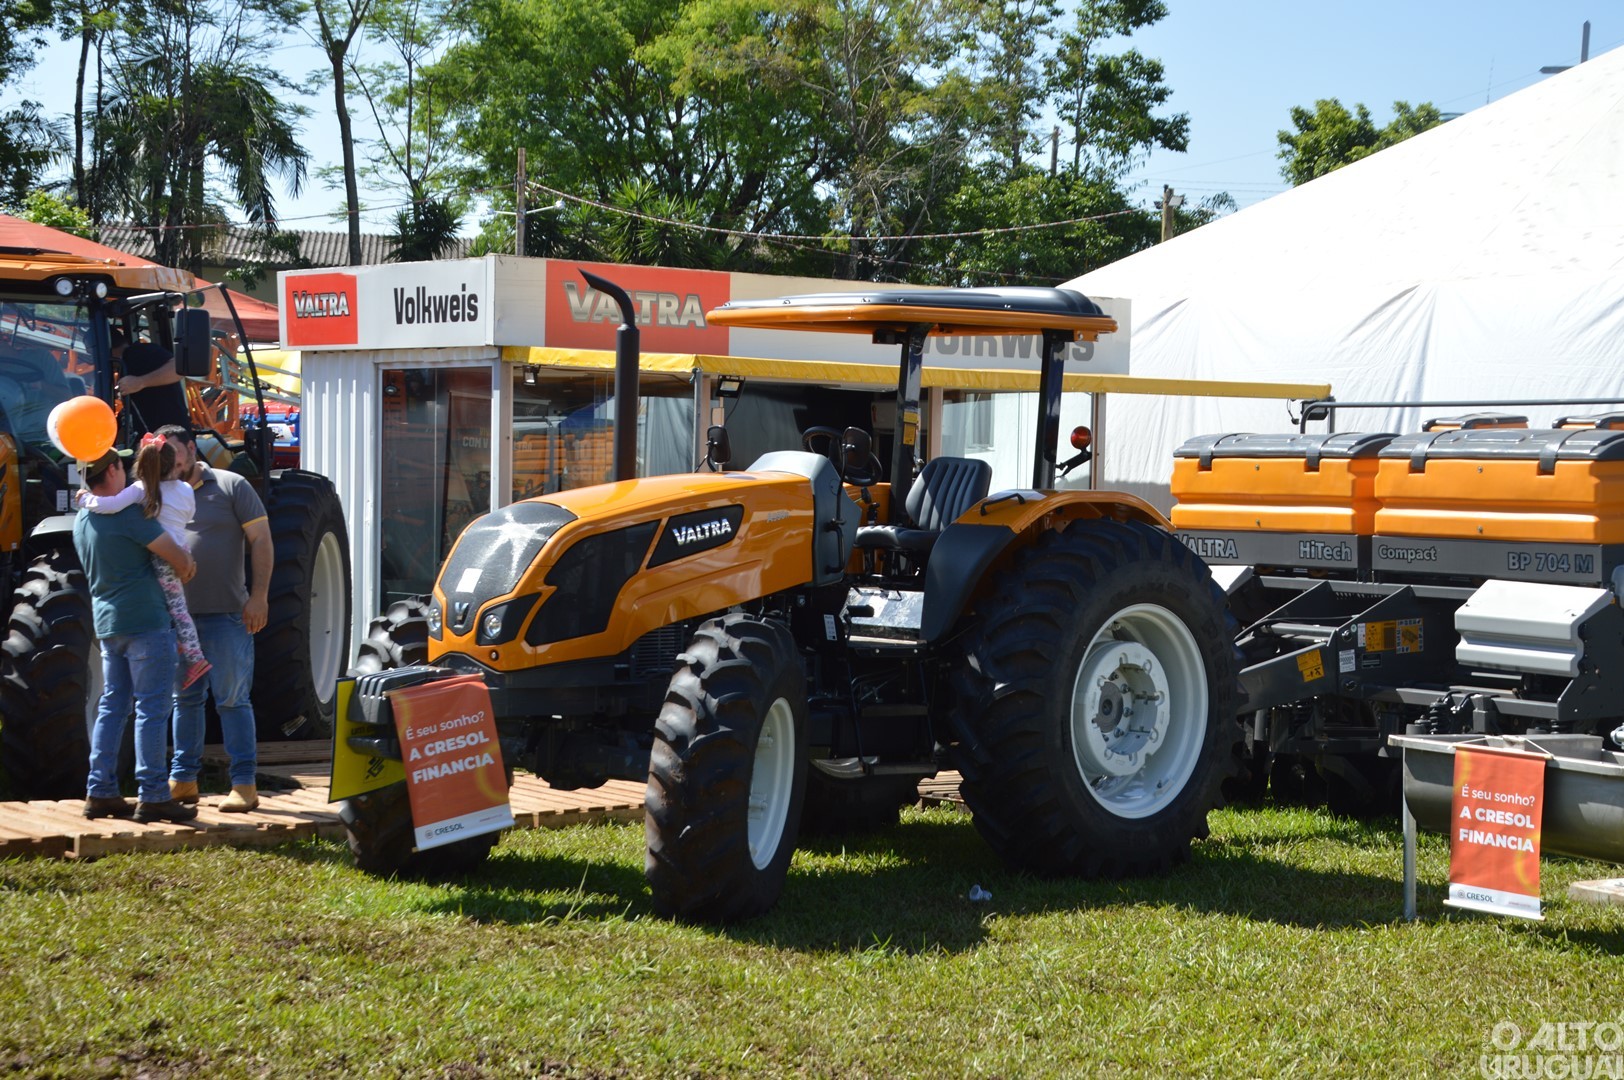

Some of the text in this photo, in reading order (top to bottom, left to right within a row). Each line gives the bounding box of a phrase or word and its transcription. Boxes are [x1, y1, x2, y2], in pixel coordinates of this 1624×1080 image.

[293, 291, 350, 319] VALTRA
[394, 283, 478, 325] Volkweis
[672, 518, 732, 546] VALTRA
[1299, 540, 1352, 561] HiTech
[1378, 544, 1437, 563] Compact
[1508, 552, 1594, 574] BP 704 M
[405, 711, 485, 741] É seu sonho?
[409, 731, 490, 762] A CRESOL
[412, 753, 495, 784] FINANCIA
[1461, 784, 1535, 807] É seu sonho?
[434, 822, 465, 836] CRESOL
[1459, 806, 1535, 829] A CRESOL
[1459, 828, 1535, 853] FINANCIA
[1466, 891, 1494, 903] CRESOL
